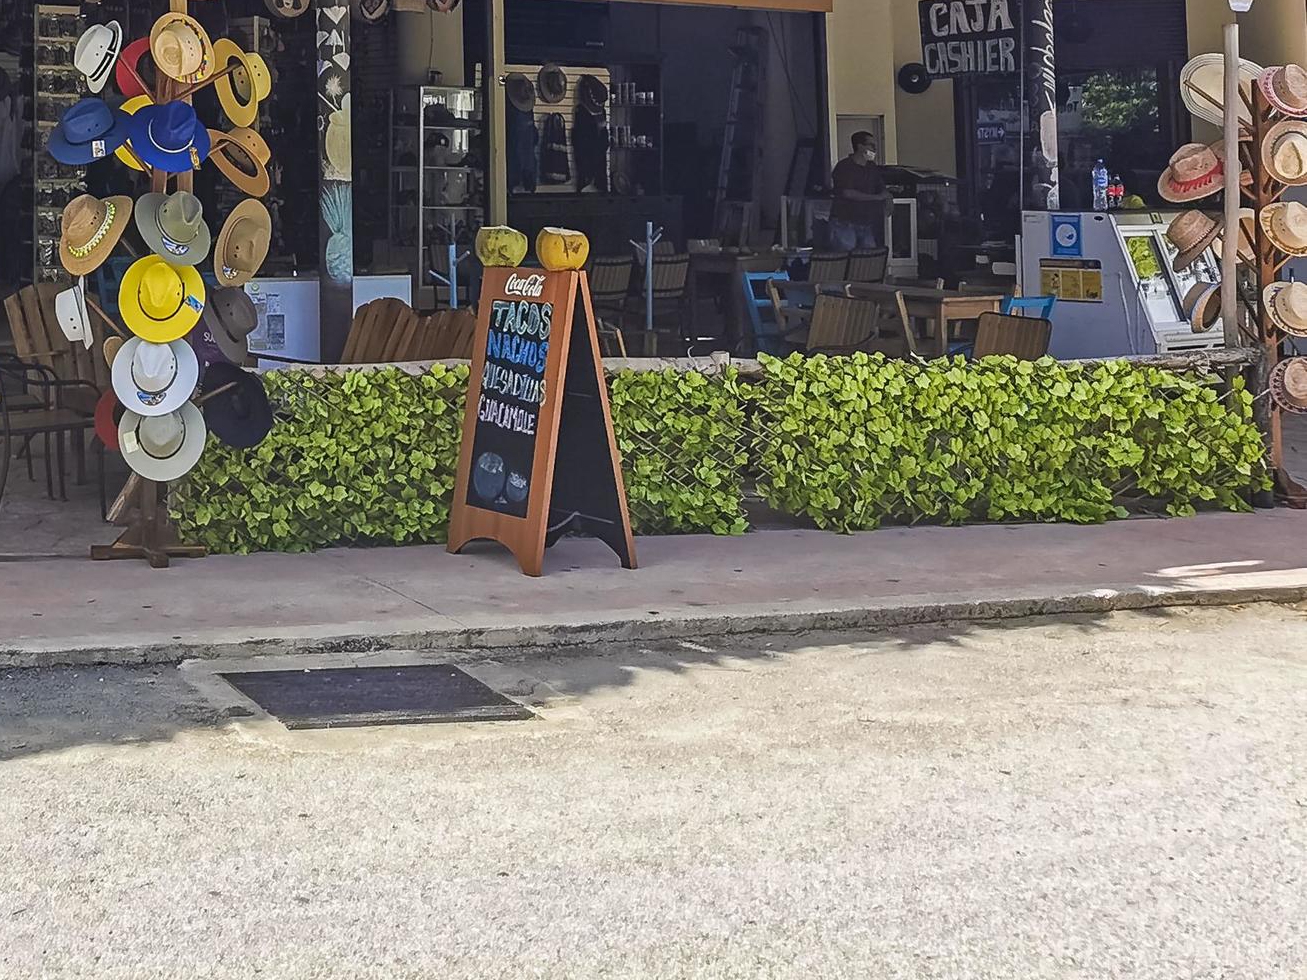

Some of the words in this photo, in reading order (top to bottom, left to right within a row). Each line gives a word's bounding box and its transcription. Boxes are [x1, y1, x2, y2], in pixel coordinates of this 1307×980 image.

[924, 37, 1015, 74] CASHIER
[493, 300, 553, 340] TACOS
[487, 329, 549, 373] NACHOS
